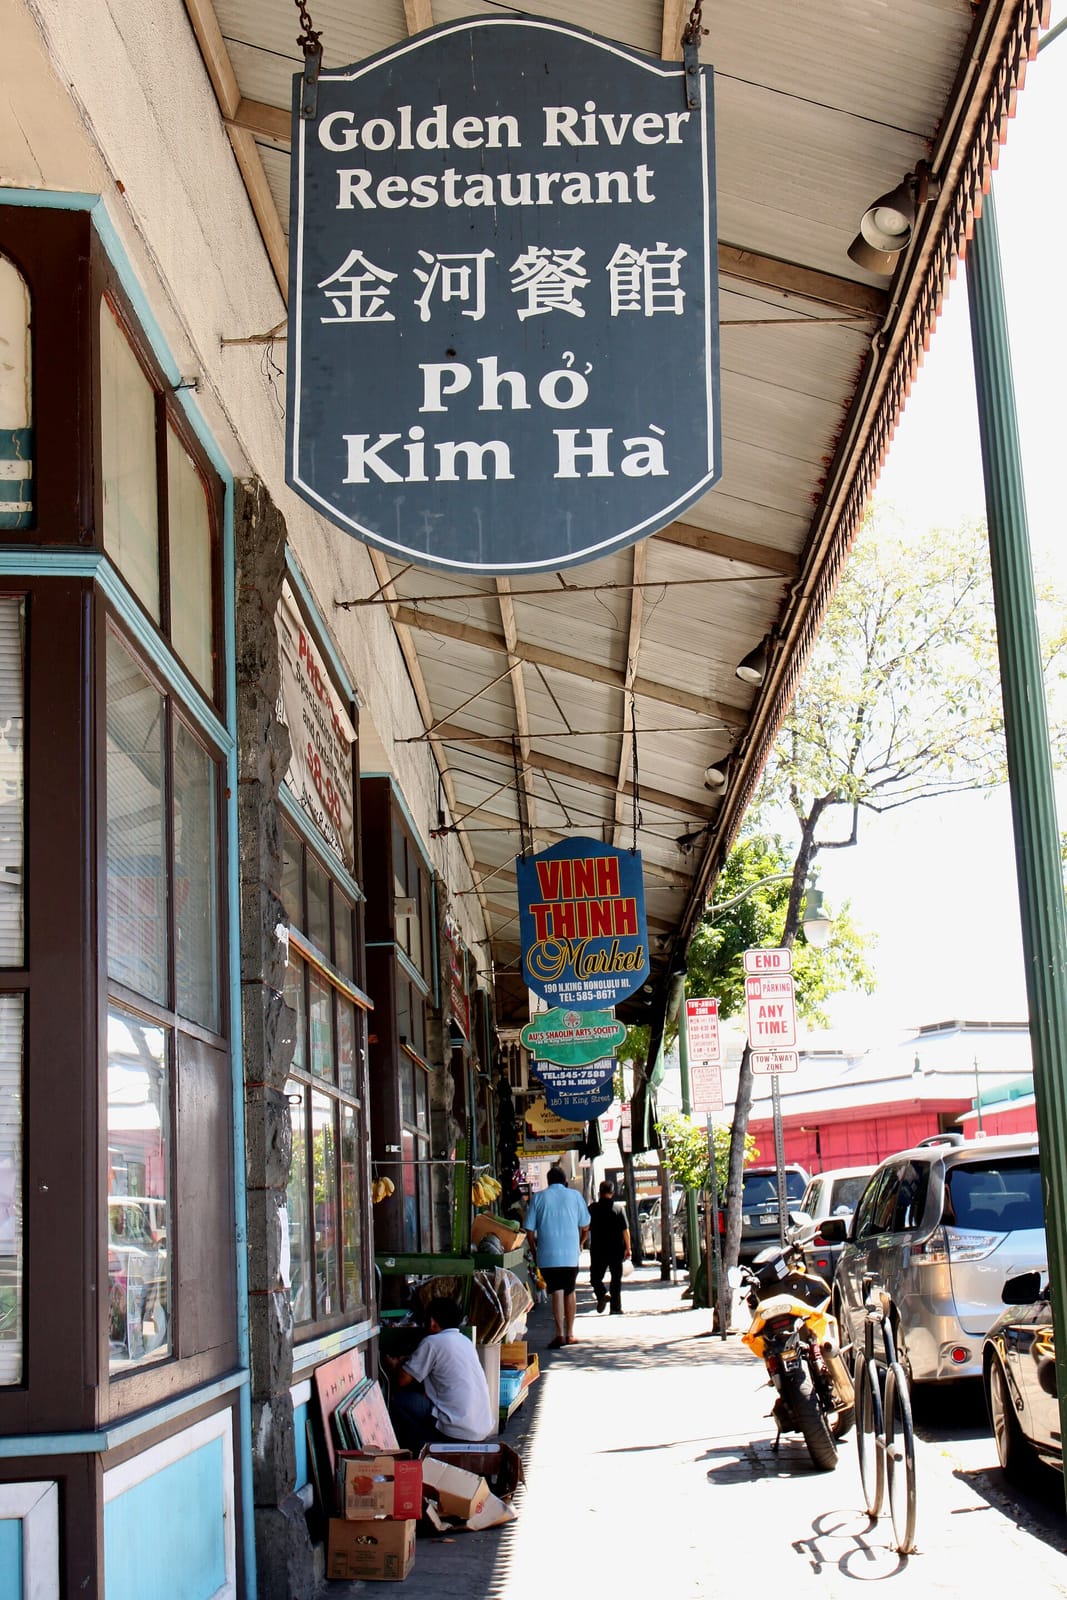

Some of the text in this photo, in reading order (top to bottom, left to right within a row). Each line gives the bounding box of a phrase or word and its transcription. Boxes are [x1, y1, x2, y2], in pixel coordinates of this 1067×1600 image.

[318, 101, 692, 153] Golden River
[336, 164, 656, 210] Restaurant
[317, 241, 689, 324] 金河餐館
[418, 350, 595, 414] Phở
[342, 424, 670, 485] Kim Hà
[295, 661, 333, 751] Specializing
[302, 709, 315, 733] and
[536, 856, 621, 901] VINH
[529, 898, 639, 942] THINH
[526, 935, 645, 982] Market
[755, 955, 781, 968] END
[544, 983, 557, 993] 190
[583, 980, 620, 991] HONOLULU
[559, 990, 616, 1002] TEL: 585-8671
[747, 981, 790, 996] NO PARKING
[759, 1005, 784, 1018] ANY
[528, 1032, 544, 1041] AU'S
[546, 1029, 573, 1039] SHAOLIN
[575, 1028, 592, 1036] ARTS
[593, 1025, 620, 1035] SOCIETY
[756, 1021, 788, 1035] TIME
[756, 1055, 793, 1063] TOW-AWAY
[766, 1063, 783, 1071] ZONE
[573, 1096, 589, 1106] King
[591, 1094, 611, 1103] Street
